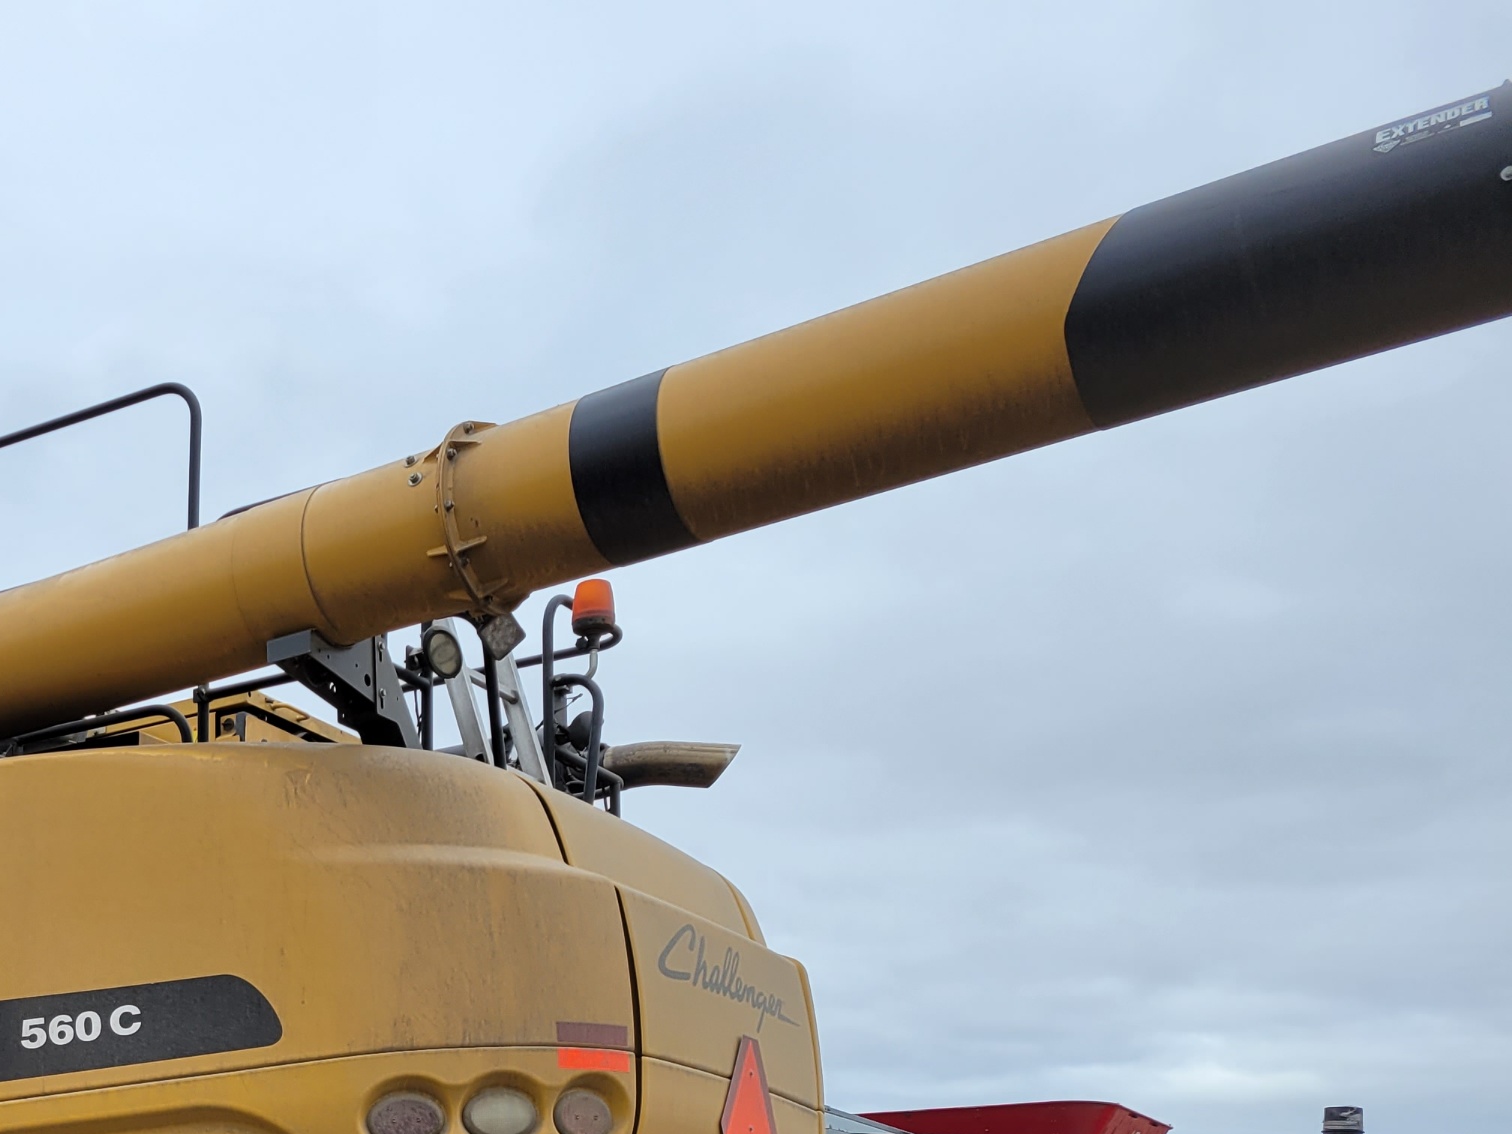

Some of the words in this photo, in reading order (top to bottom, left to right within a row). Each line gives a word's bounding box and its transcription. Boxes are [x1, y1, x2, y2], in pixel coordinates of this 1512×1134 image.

[1375, 97, 1490, 143] EXTENDER
[657, 923, 801, 1034] Challenger
[20, 1010, 102, 1049] 560
[109, 1004, 142, 1036] C
